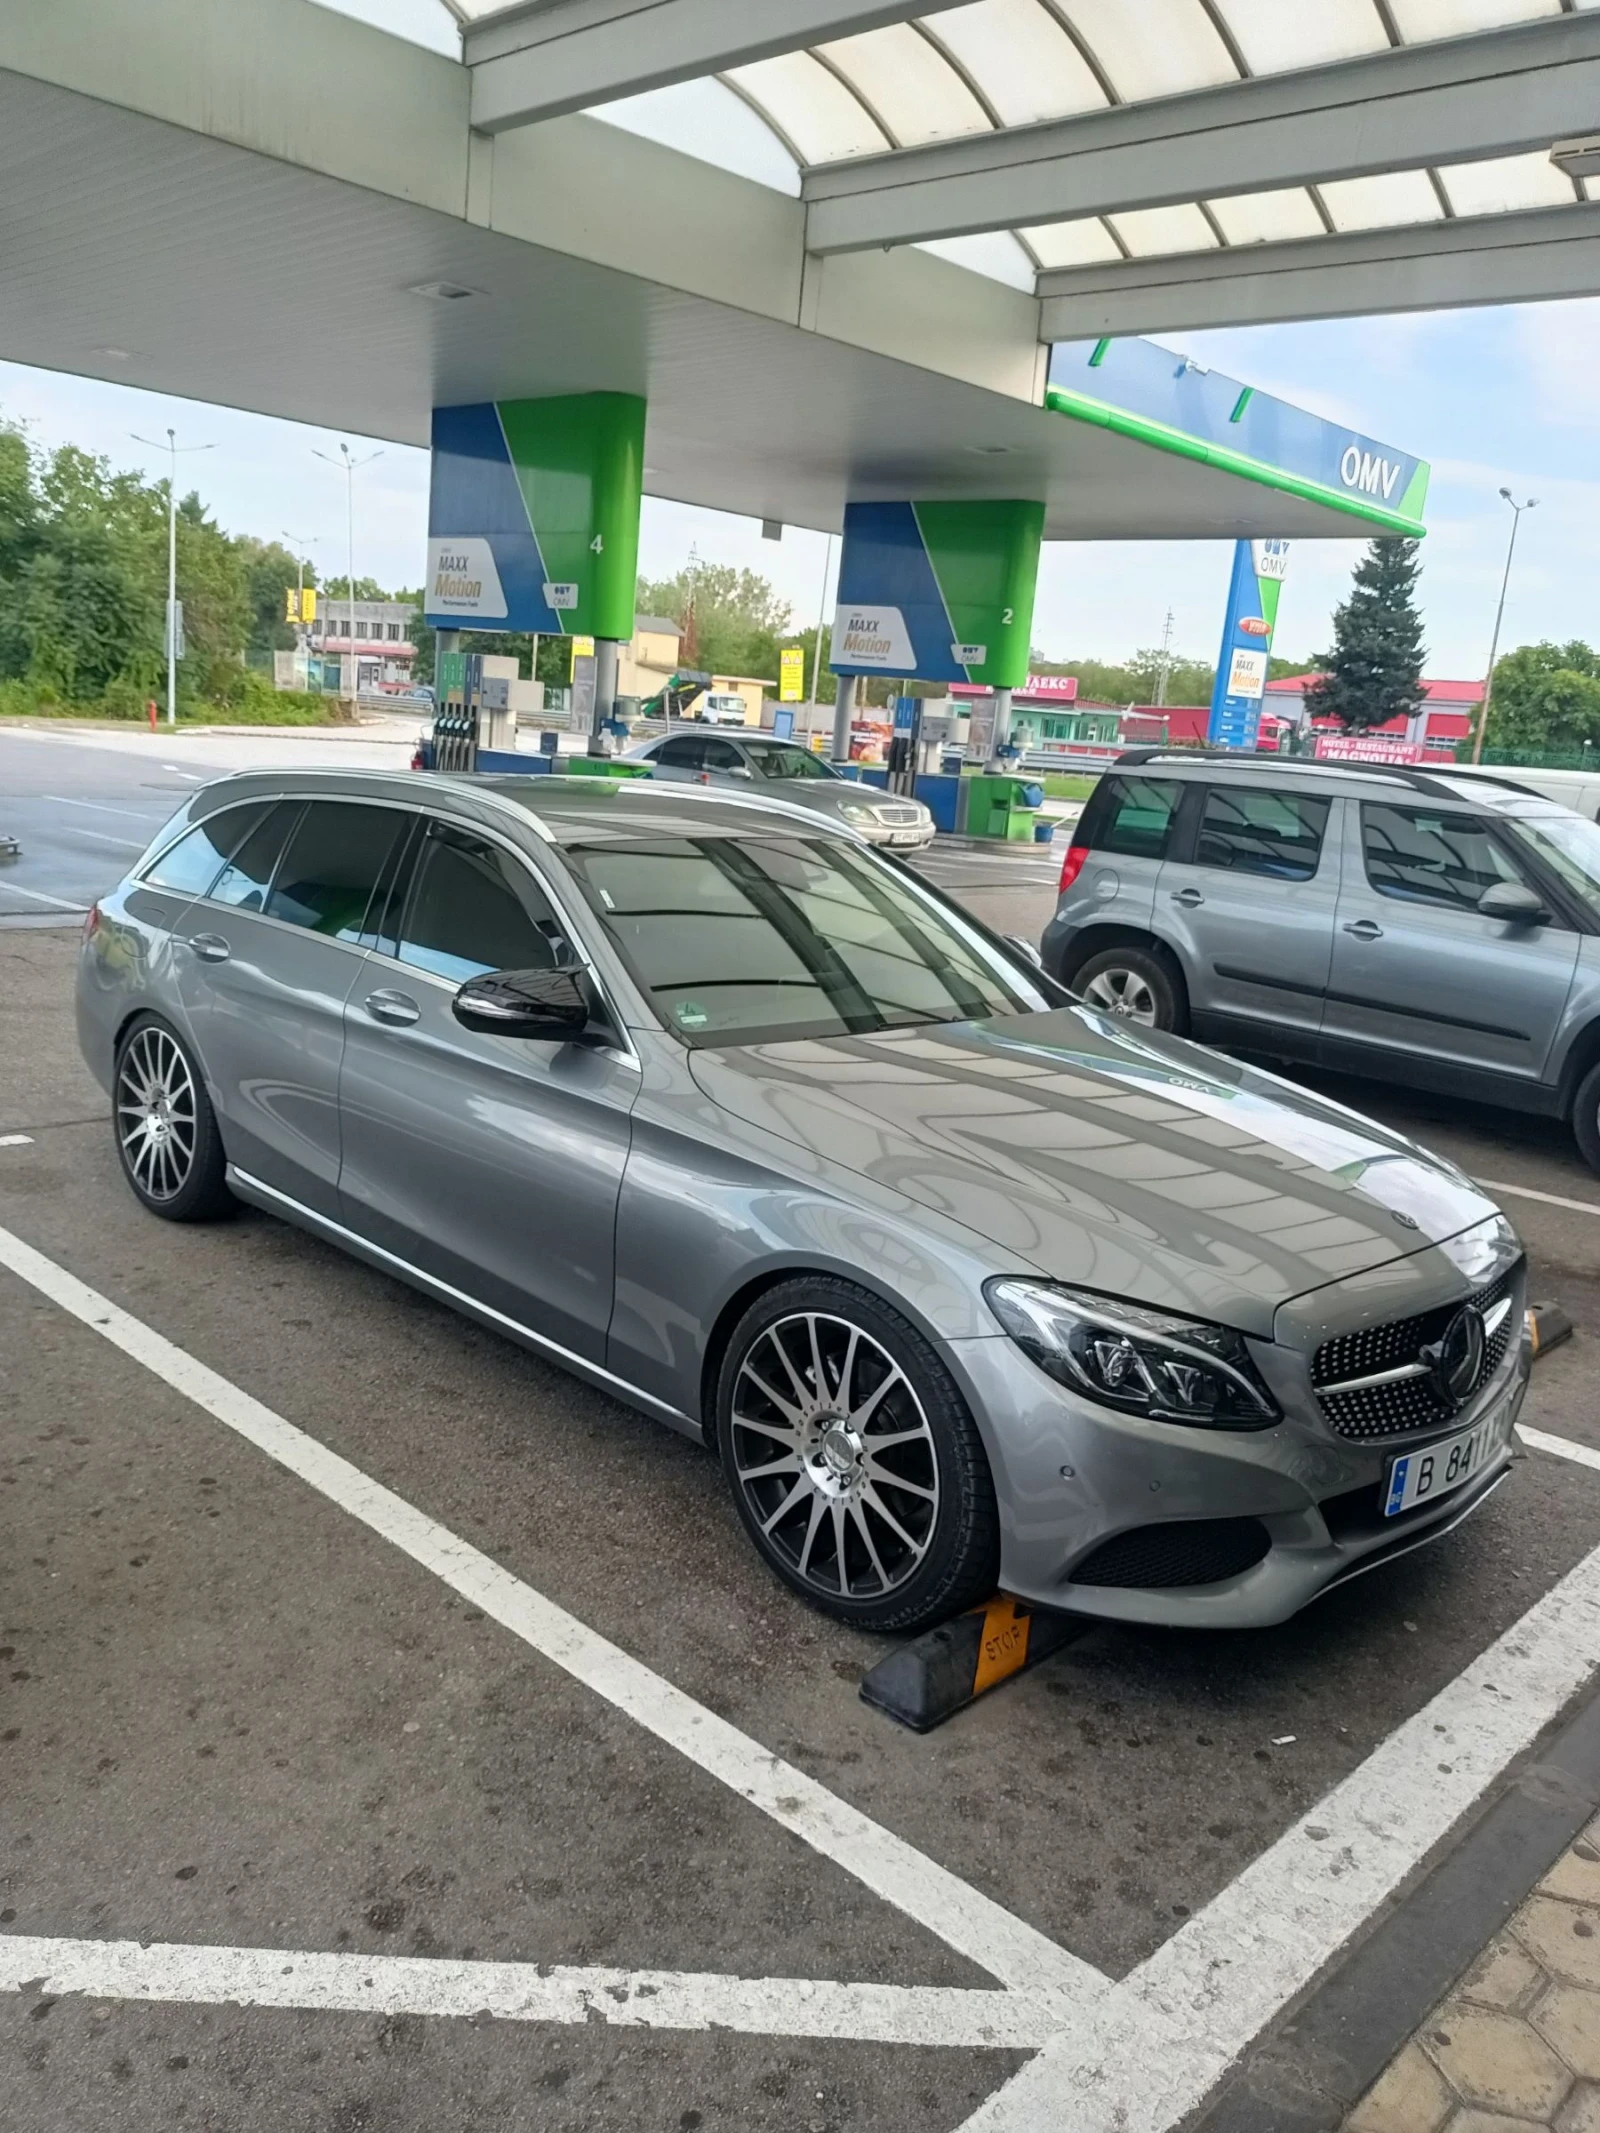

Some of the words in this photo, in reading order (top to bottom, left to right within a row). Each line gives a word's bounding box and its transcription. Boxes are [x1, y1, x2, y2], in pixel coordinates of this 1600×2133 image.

[1341, 446, 1400, 499] OMV
[589, 534, 604, 555] 4
[438, 556, 469, 572] MAXX
[1261, 557, 1287, 575] OMV
[435, 574, 482, 598] Motion
[1001, 608, 1014, 624] 2
[848, 619, 880, 632] MAXX
[843, 633, 891, 654] Motion
[1235, 659, 1254, 672] MAXX
[1231, 671, 1260, 689] Motion
[1326, 750, 1404, 764] MAGNOLIA
[1355, 742, 1415, 754] RESTAURANT
[1416, 1456, 1435, 1496] B
[985, 1626, 1021, 1661] STOP
